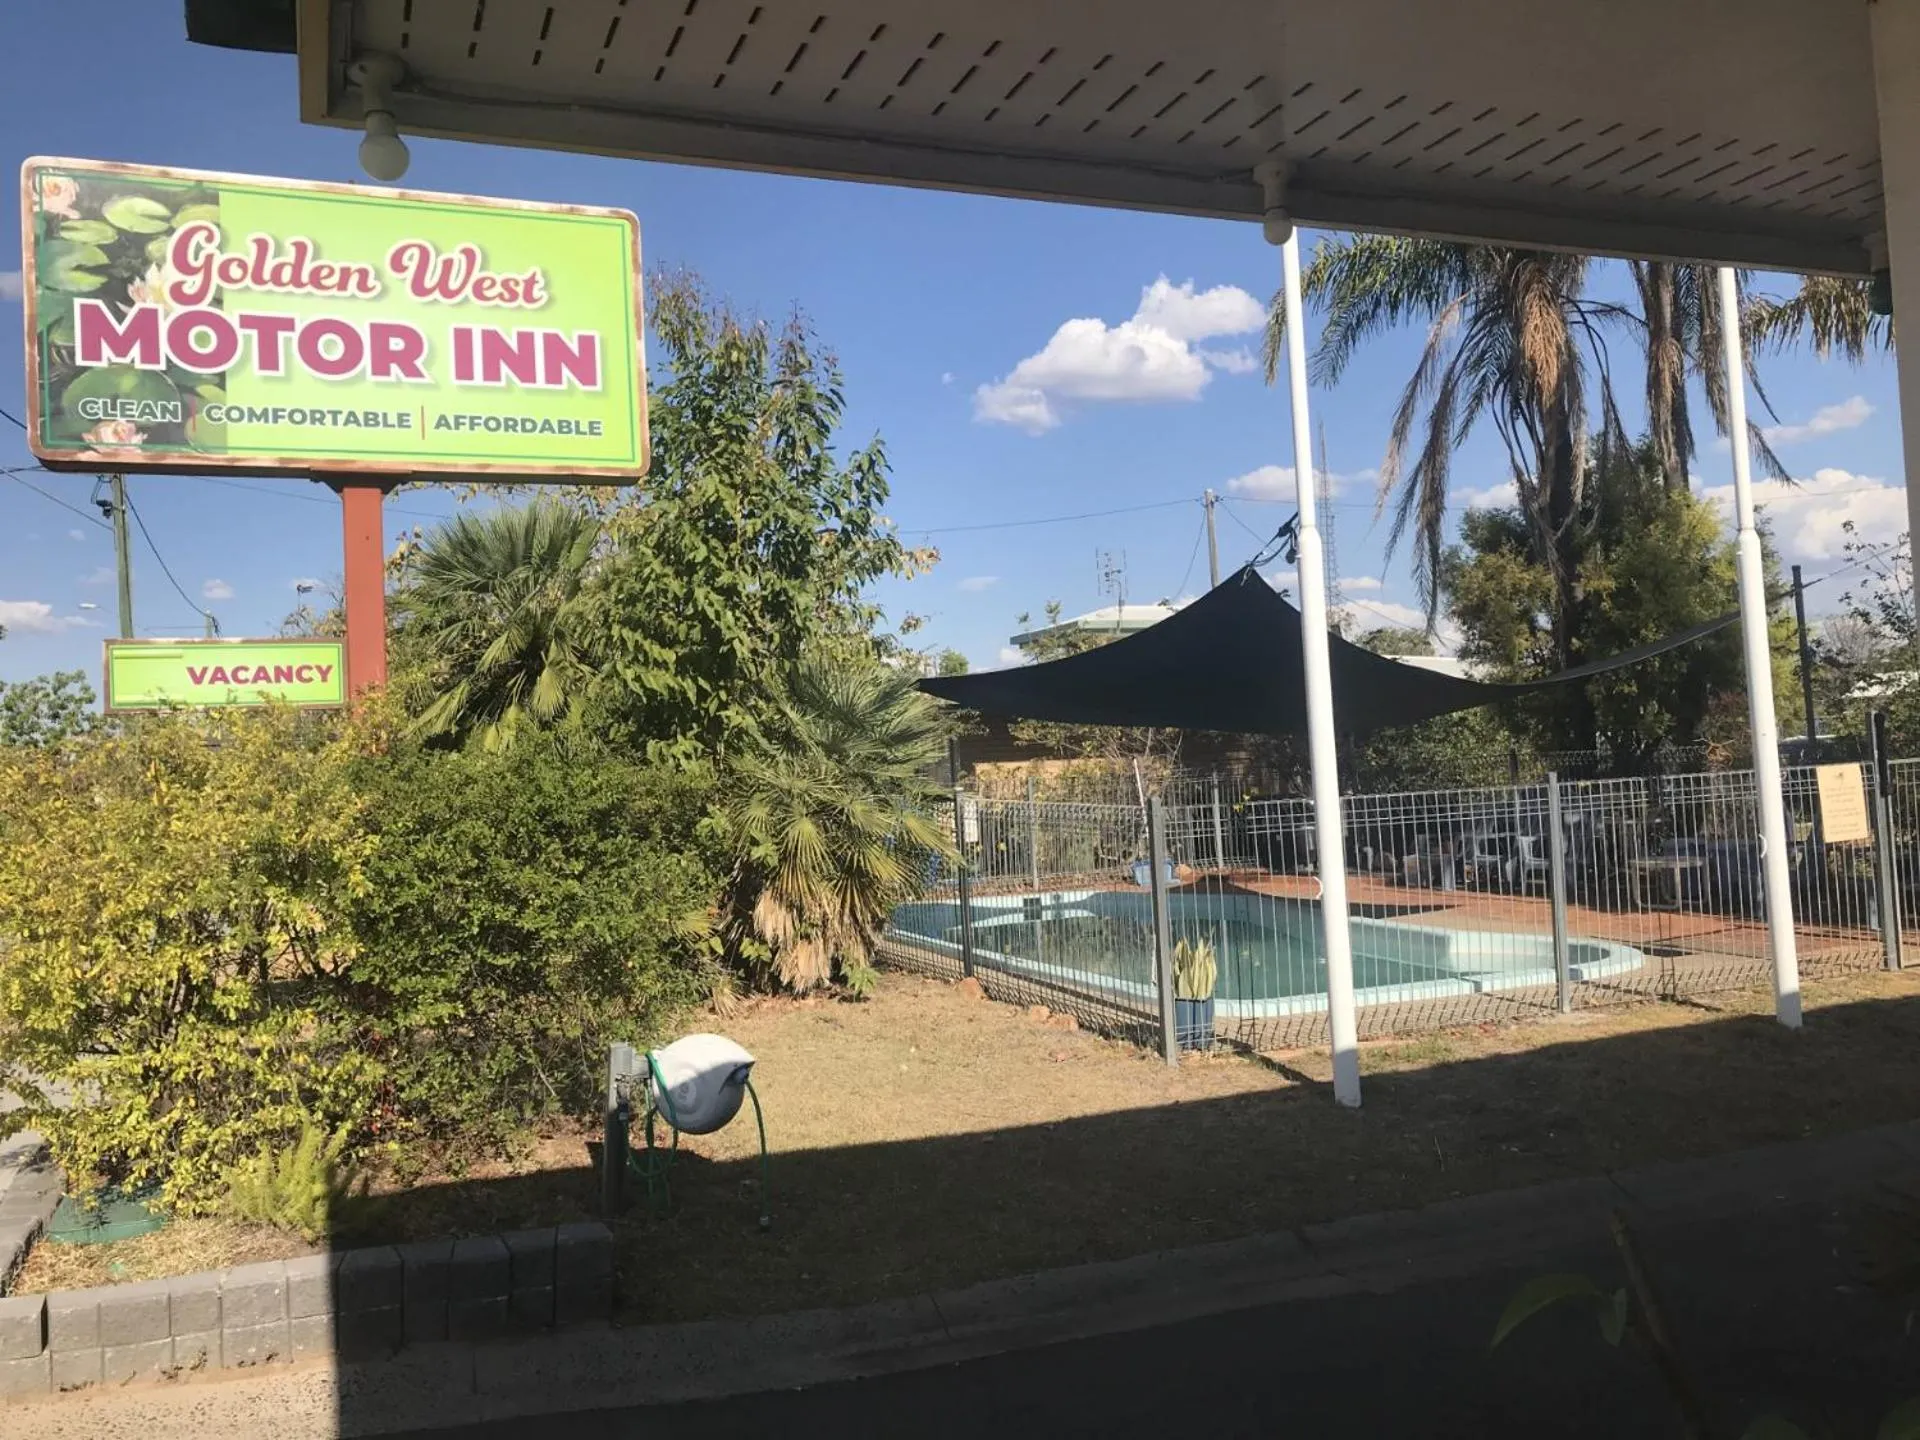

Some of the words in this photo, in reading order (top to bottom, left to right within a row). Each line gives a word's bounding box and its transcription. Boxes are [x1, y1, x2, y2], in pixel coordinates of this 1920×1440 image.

[170, 224, 376, 304] Golden
[390, 243, 543, 305] West
[78, 302, 427, 380] MOTOR
[452, 328, 599, 388] INN
[78, 397, 182, 422] CLEAN
[205, 405, 412, 430] COMFORTABLE
[434, 413, 603, 437] AFFORDABLE
[186, 664, 333, 685] VACANCY
